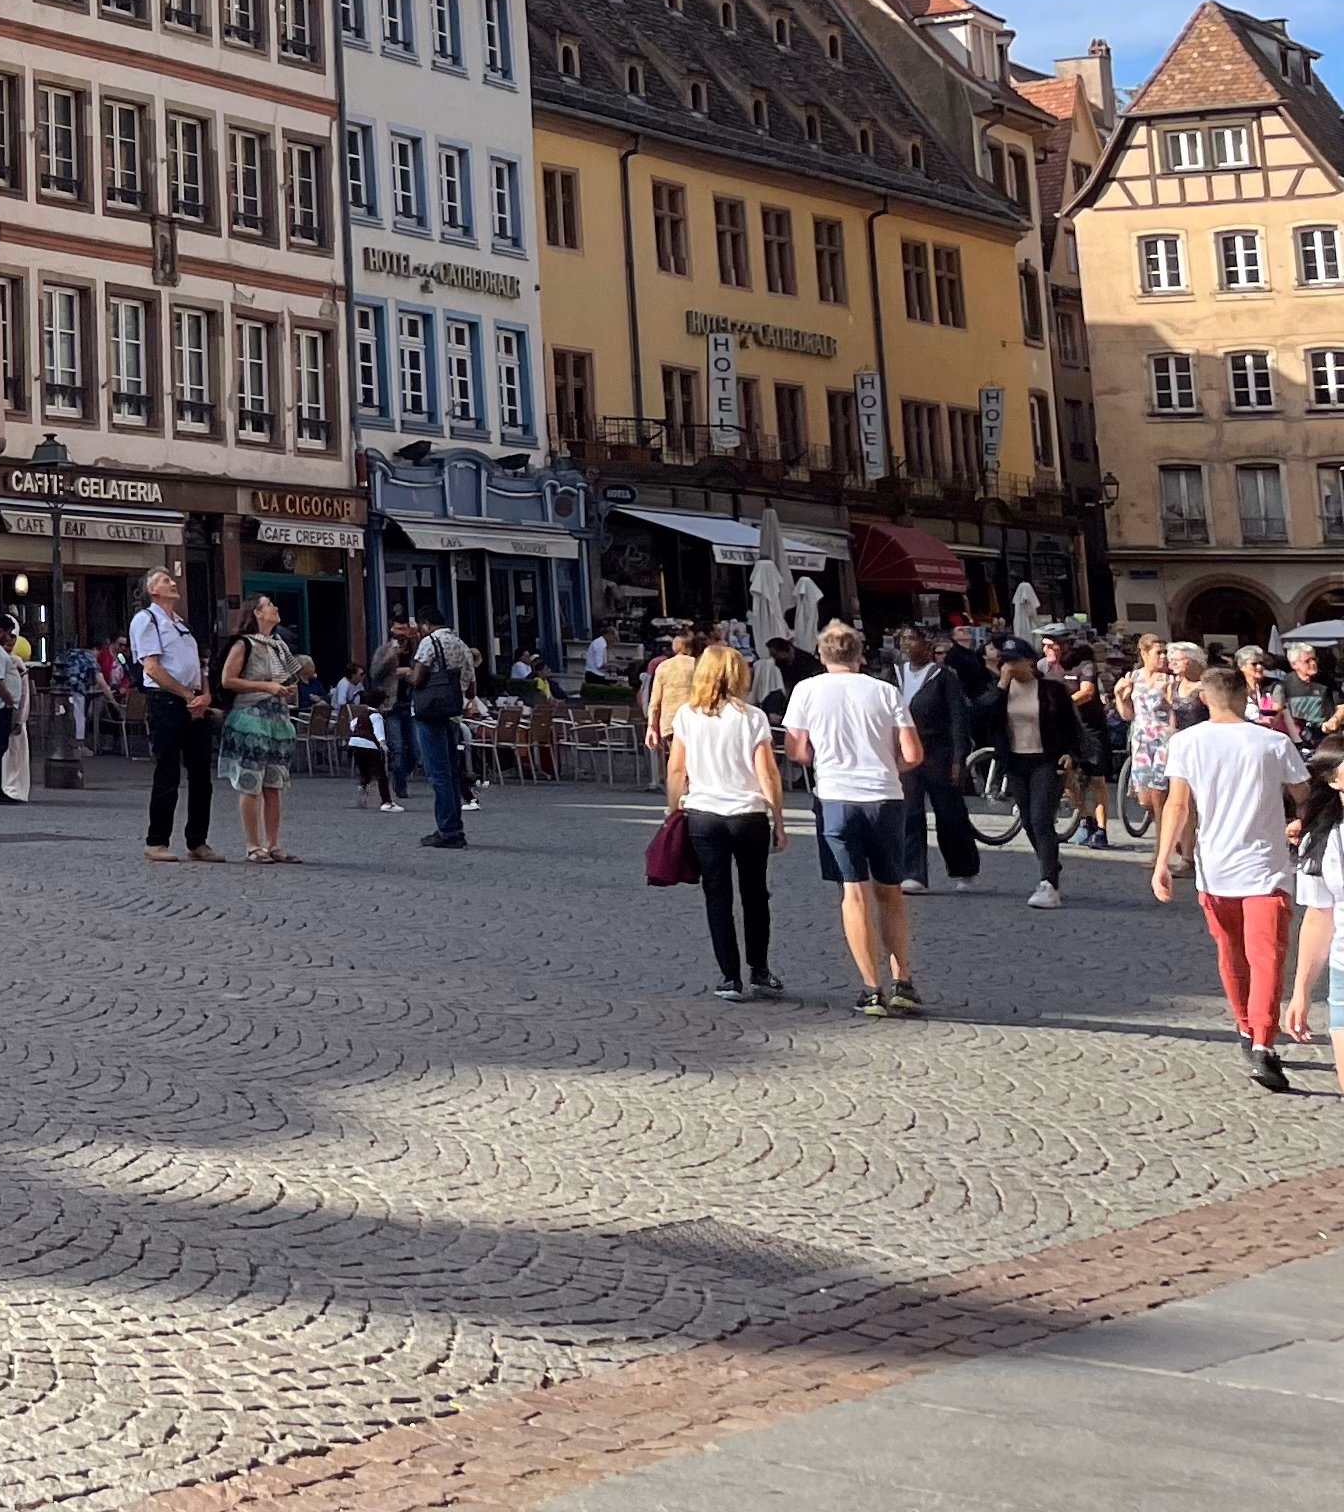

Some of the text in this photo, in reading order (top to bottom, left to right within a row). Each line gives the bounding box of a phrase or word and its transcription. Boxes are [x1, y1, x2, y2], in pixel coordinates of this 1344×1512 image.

[365, 247, 412, 277] HOTEL
[713, 337, 733, 432] HOTEL
[860, 377, 878, 464] HOTEL
[78, 476, 163, 503] GELATERIA
[257, 490, 280, 513] LA
[64, 521, 87, 537] BAR
[107, 524, 166, 543] GELATERIA
[296, 529, 335, 545] CREPES
[339, 532, 359, 547] BAR
